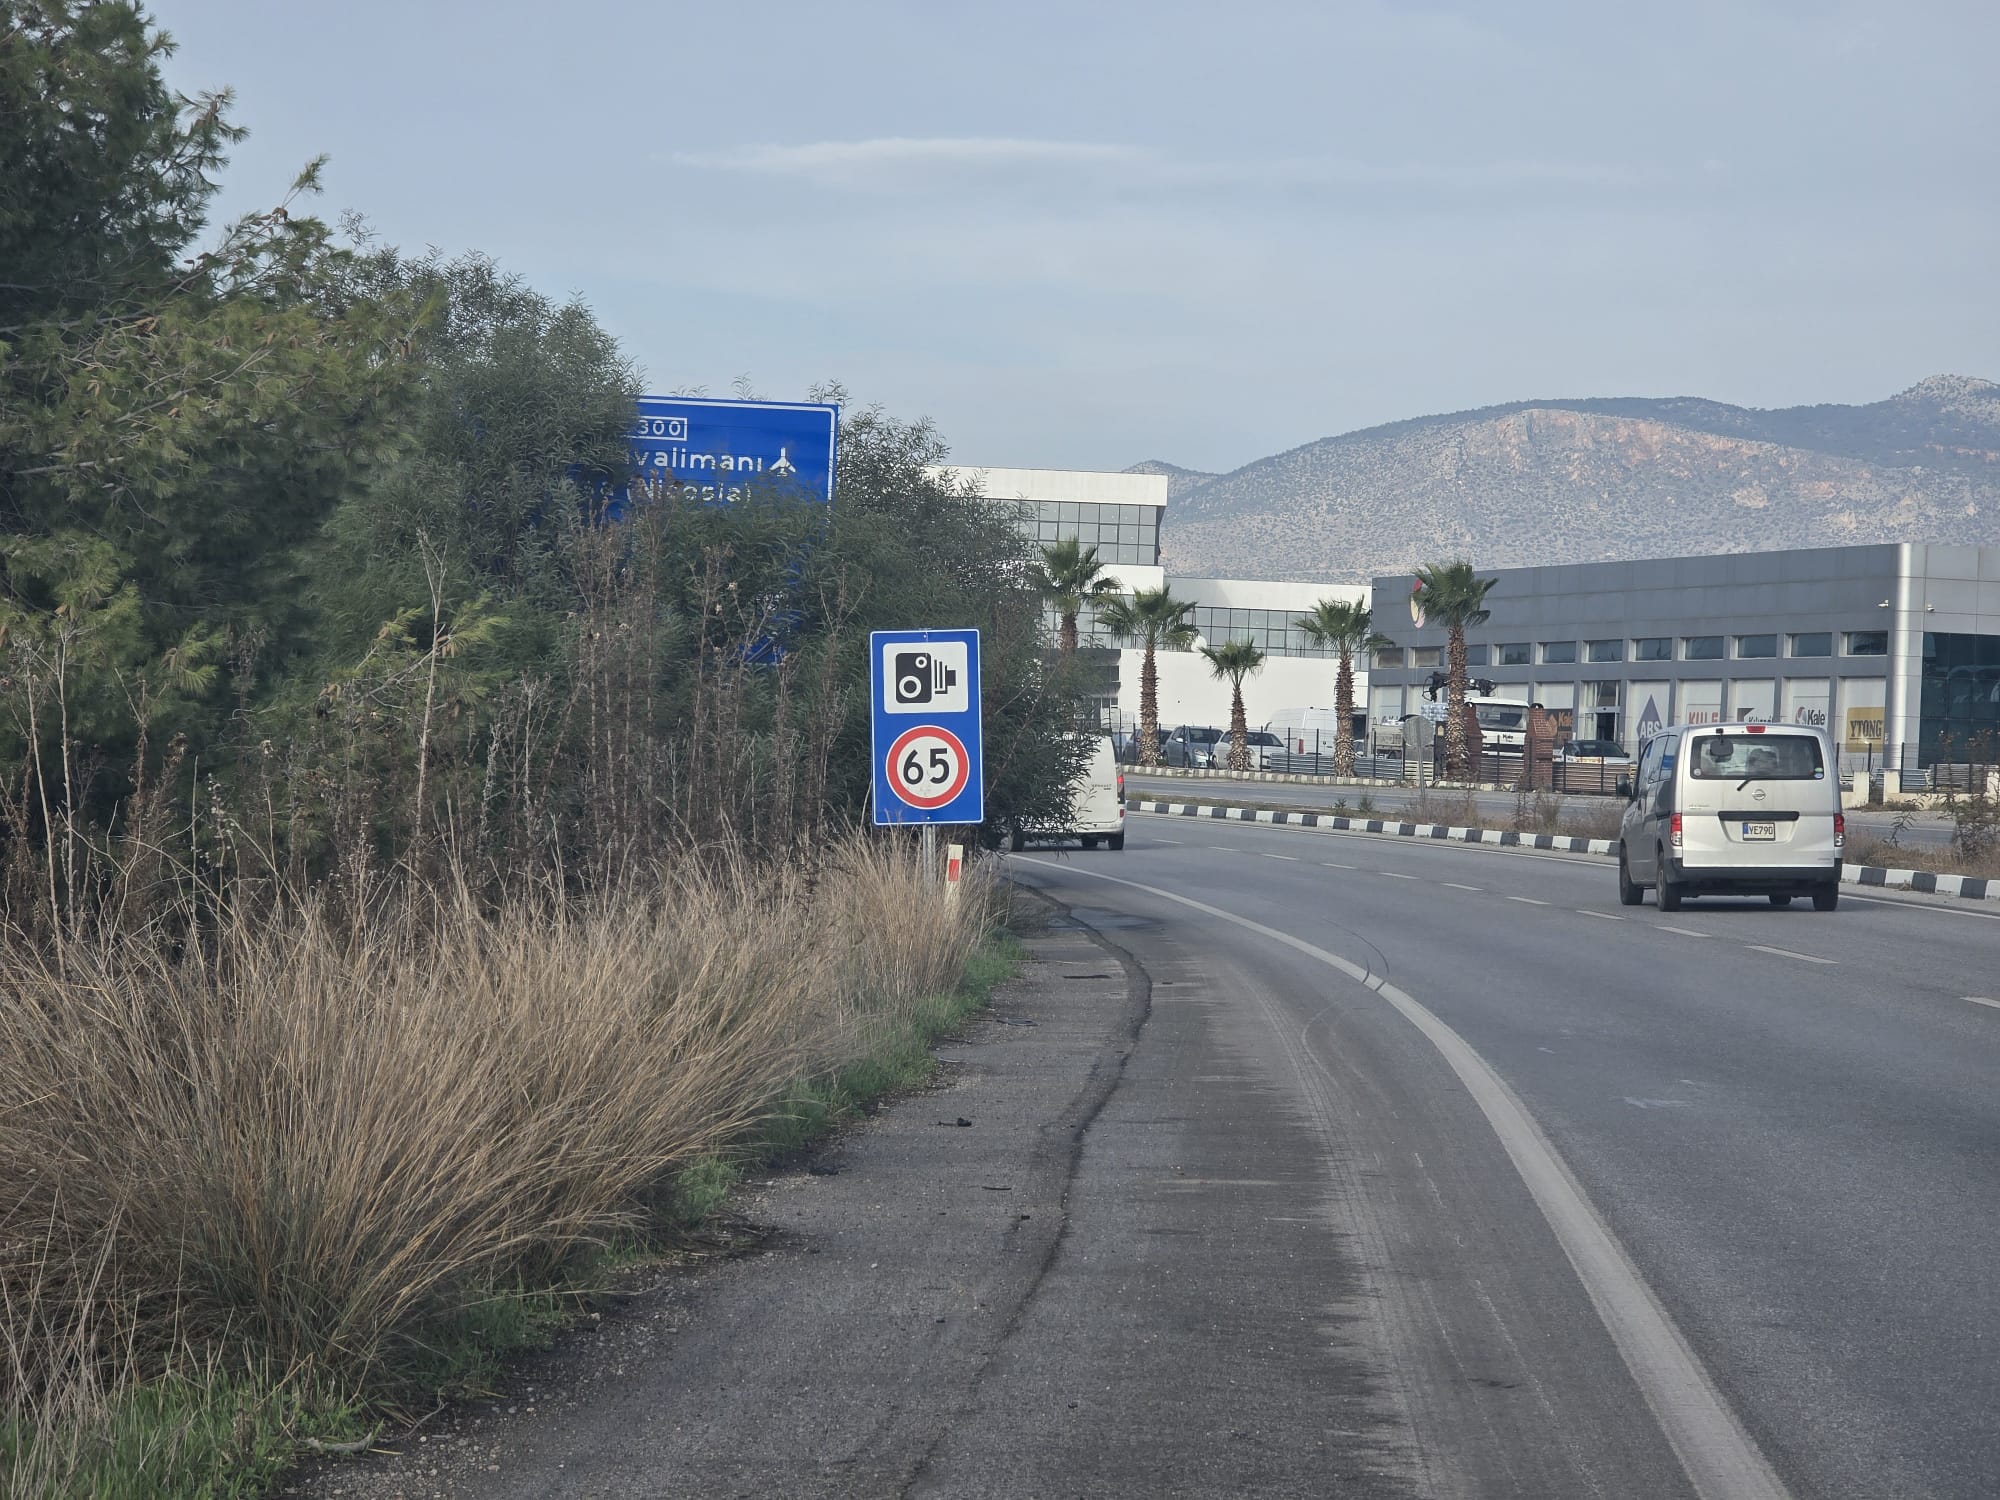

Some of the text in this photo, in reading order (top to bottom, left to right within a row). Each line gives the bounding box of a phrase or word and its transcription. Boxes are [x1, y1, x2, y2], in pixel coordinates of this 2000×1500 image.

[1808, 710, 1826, 726] Kale
[1640, 720, 1662, 739] ABS
[1850, 720, 1882, 737] YTONG
[903, 748, 950, 785] 65
